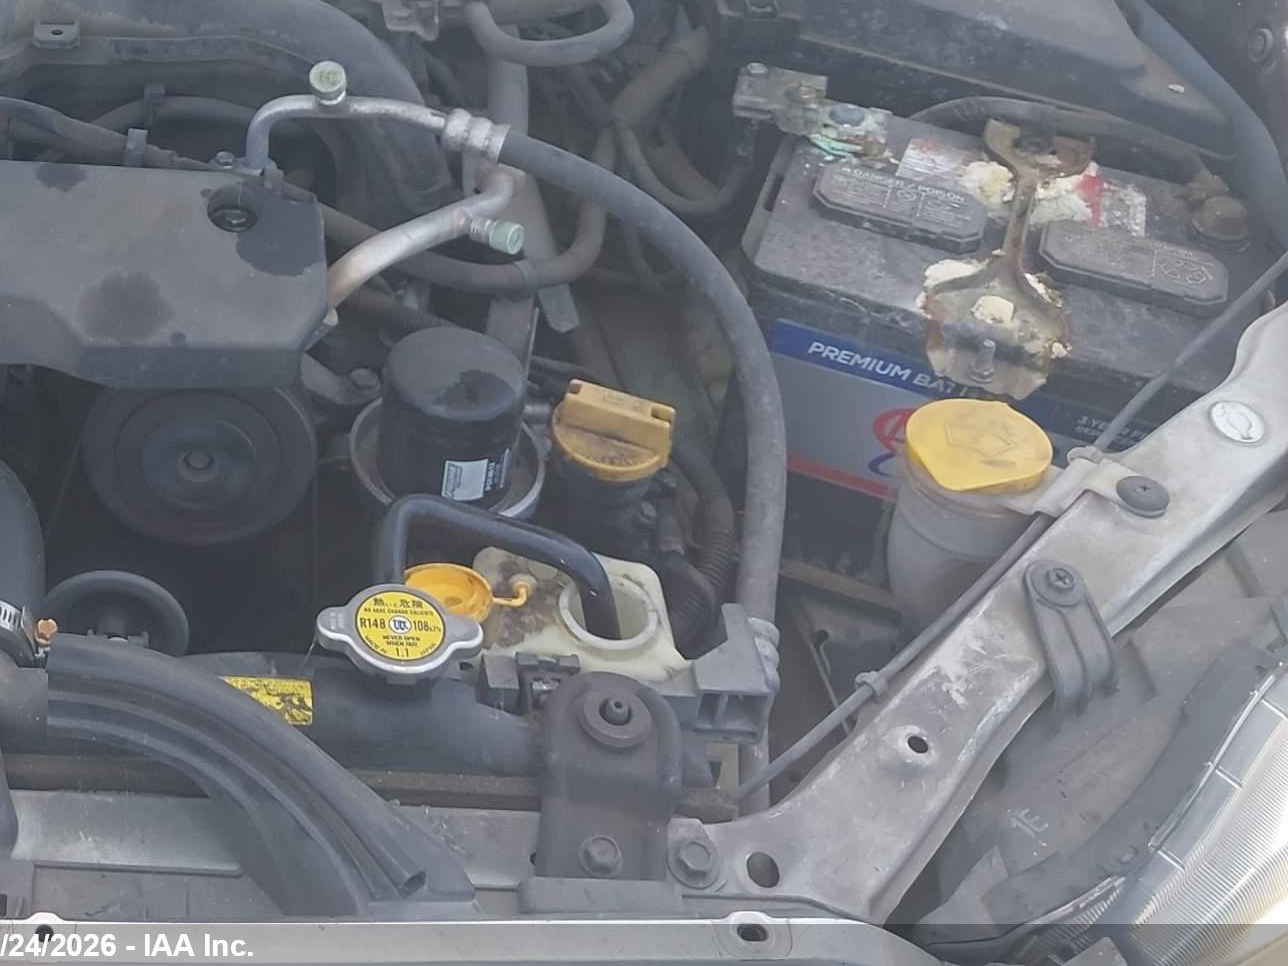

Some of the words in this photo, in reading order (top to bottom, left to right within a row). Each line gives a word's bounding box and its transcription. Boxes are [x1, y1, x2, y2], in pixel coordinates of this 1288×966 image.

[808, 341, 912, 381] PREMIUM
[359, 617, 386, 630] R148
[395, 647, 410, 658] 1.1
